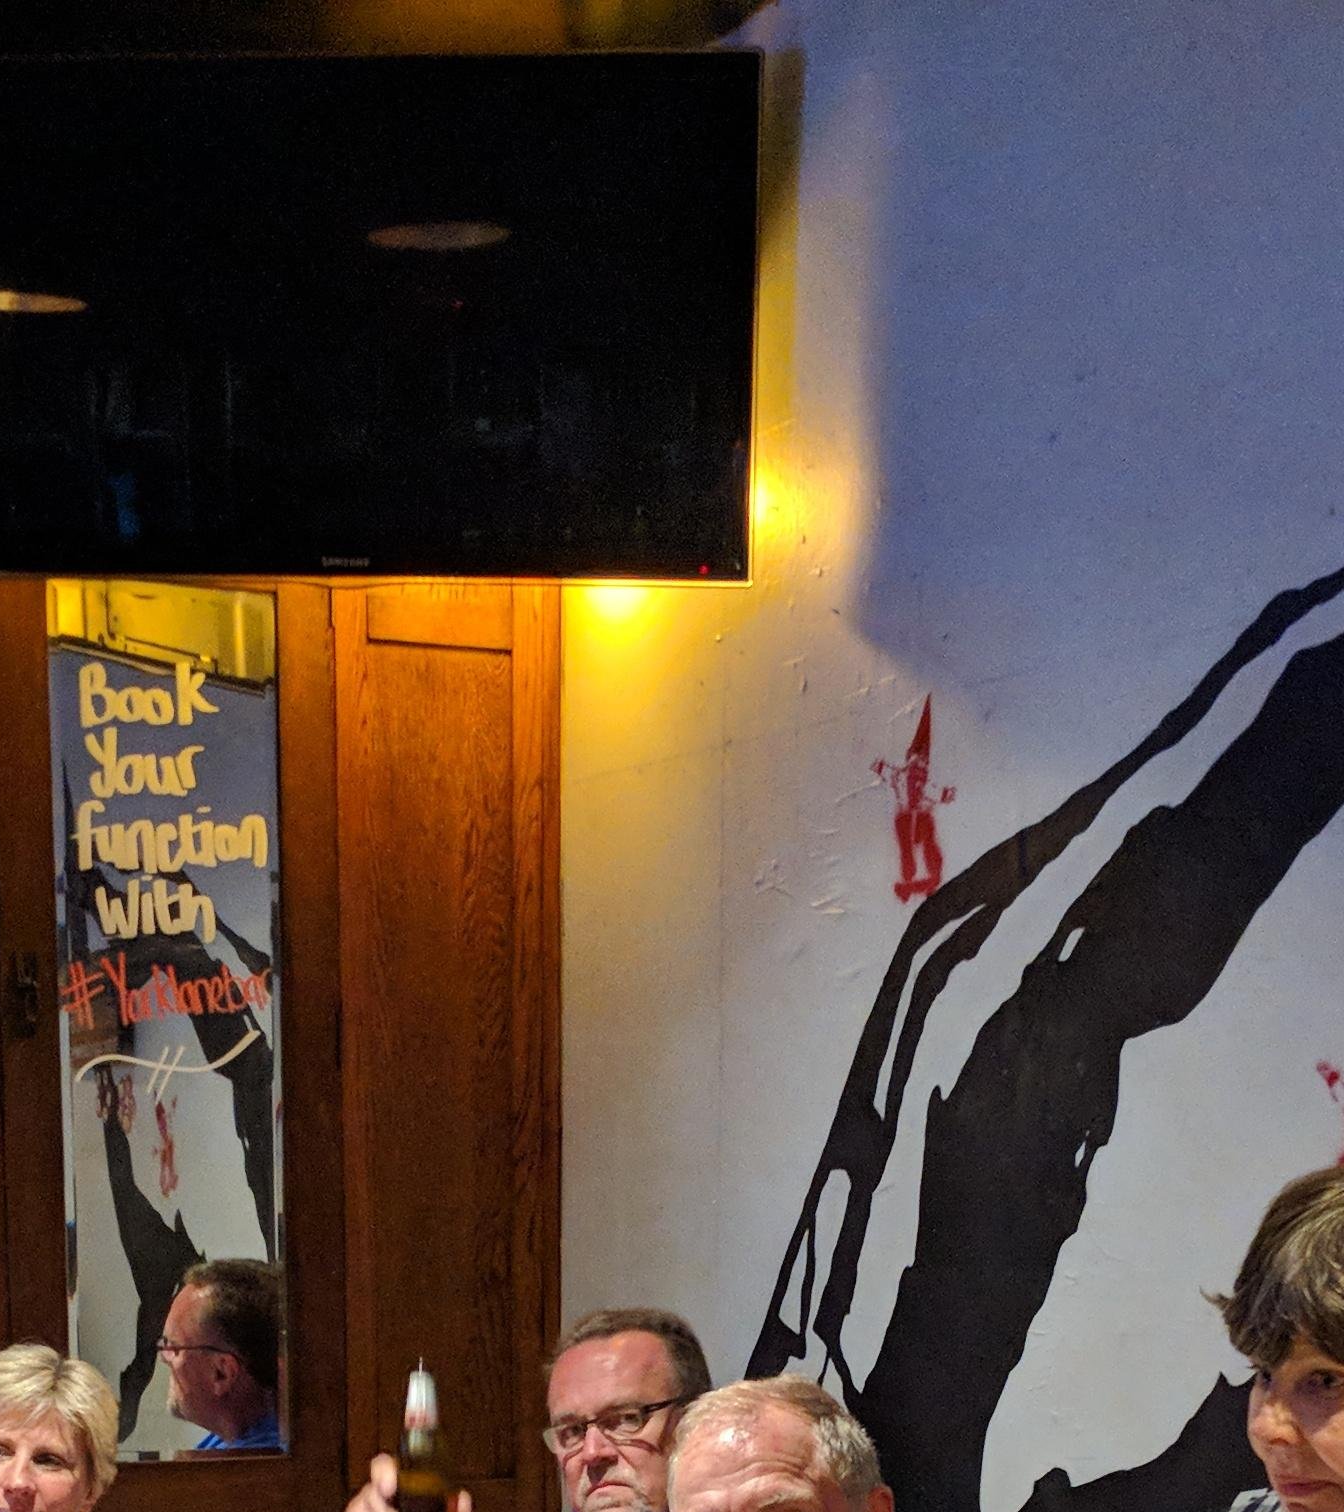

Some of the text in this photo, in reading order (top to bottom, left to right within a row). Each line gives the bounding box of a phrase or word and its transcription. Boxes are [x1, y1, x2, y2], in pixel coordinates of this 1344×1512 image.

[77, 661, 220, 728] Book
[84, 726, 205, 799] Your
[70, 800, 269, 874] function
